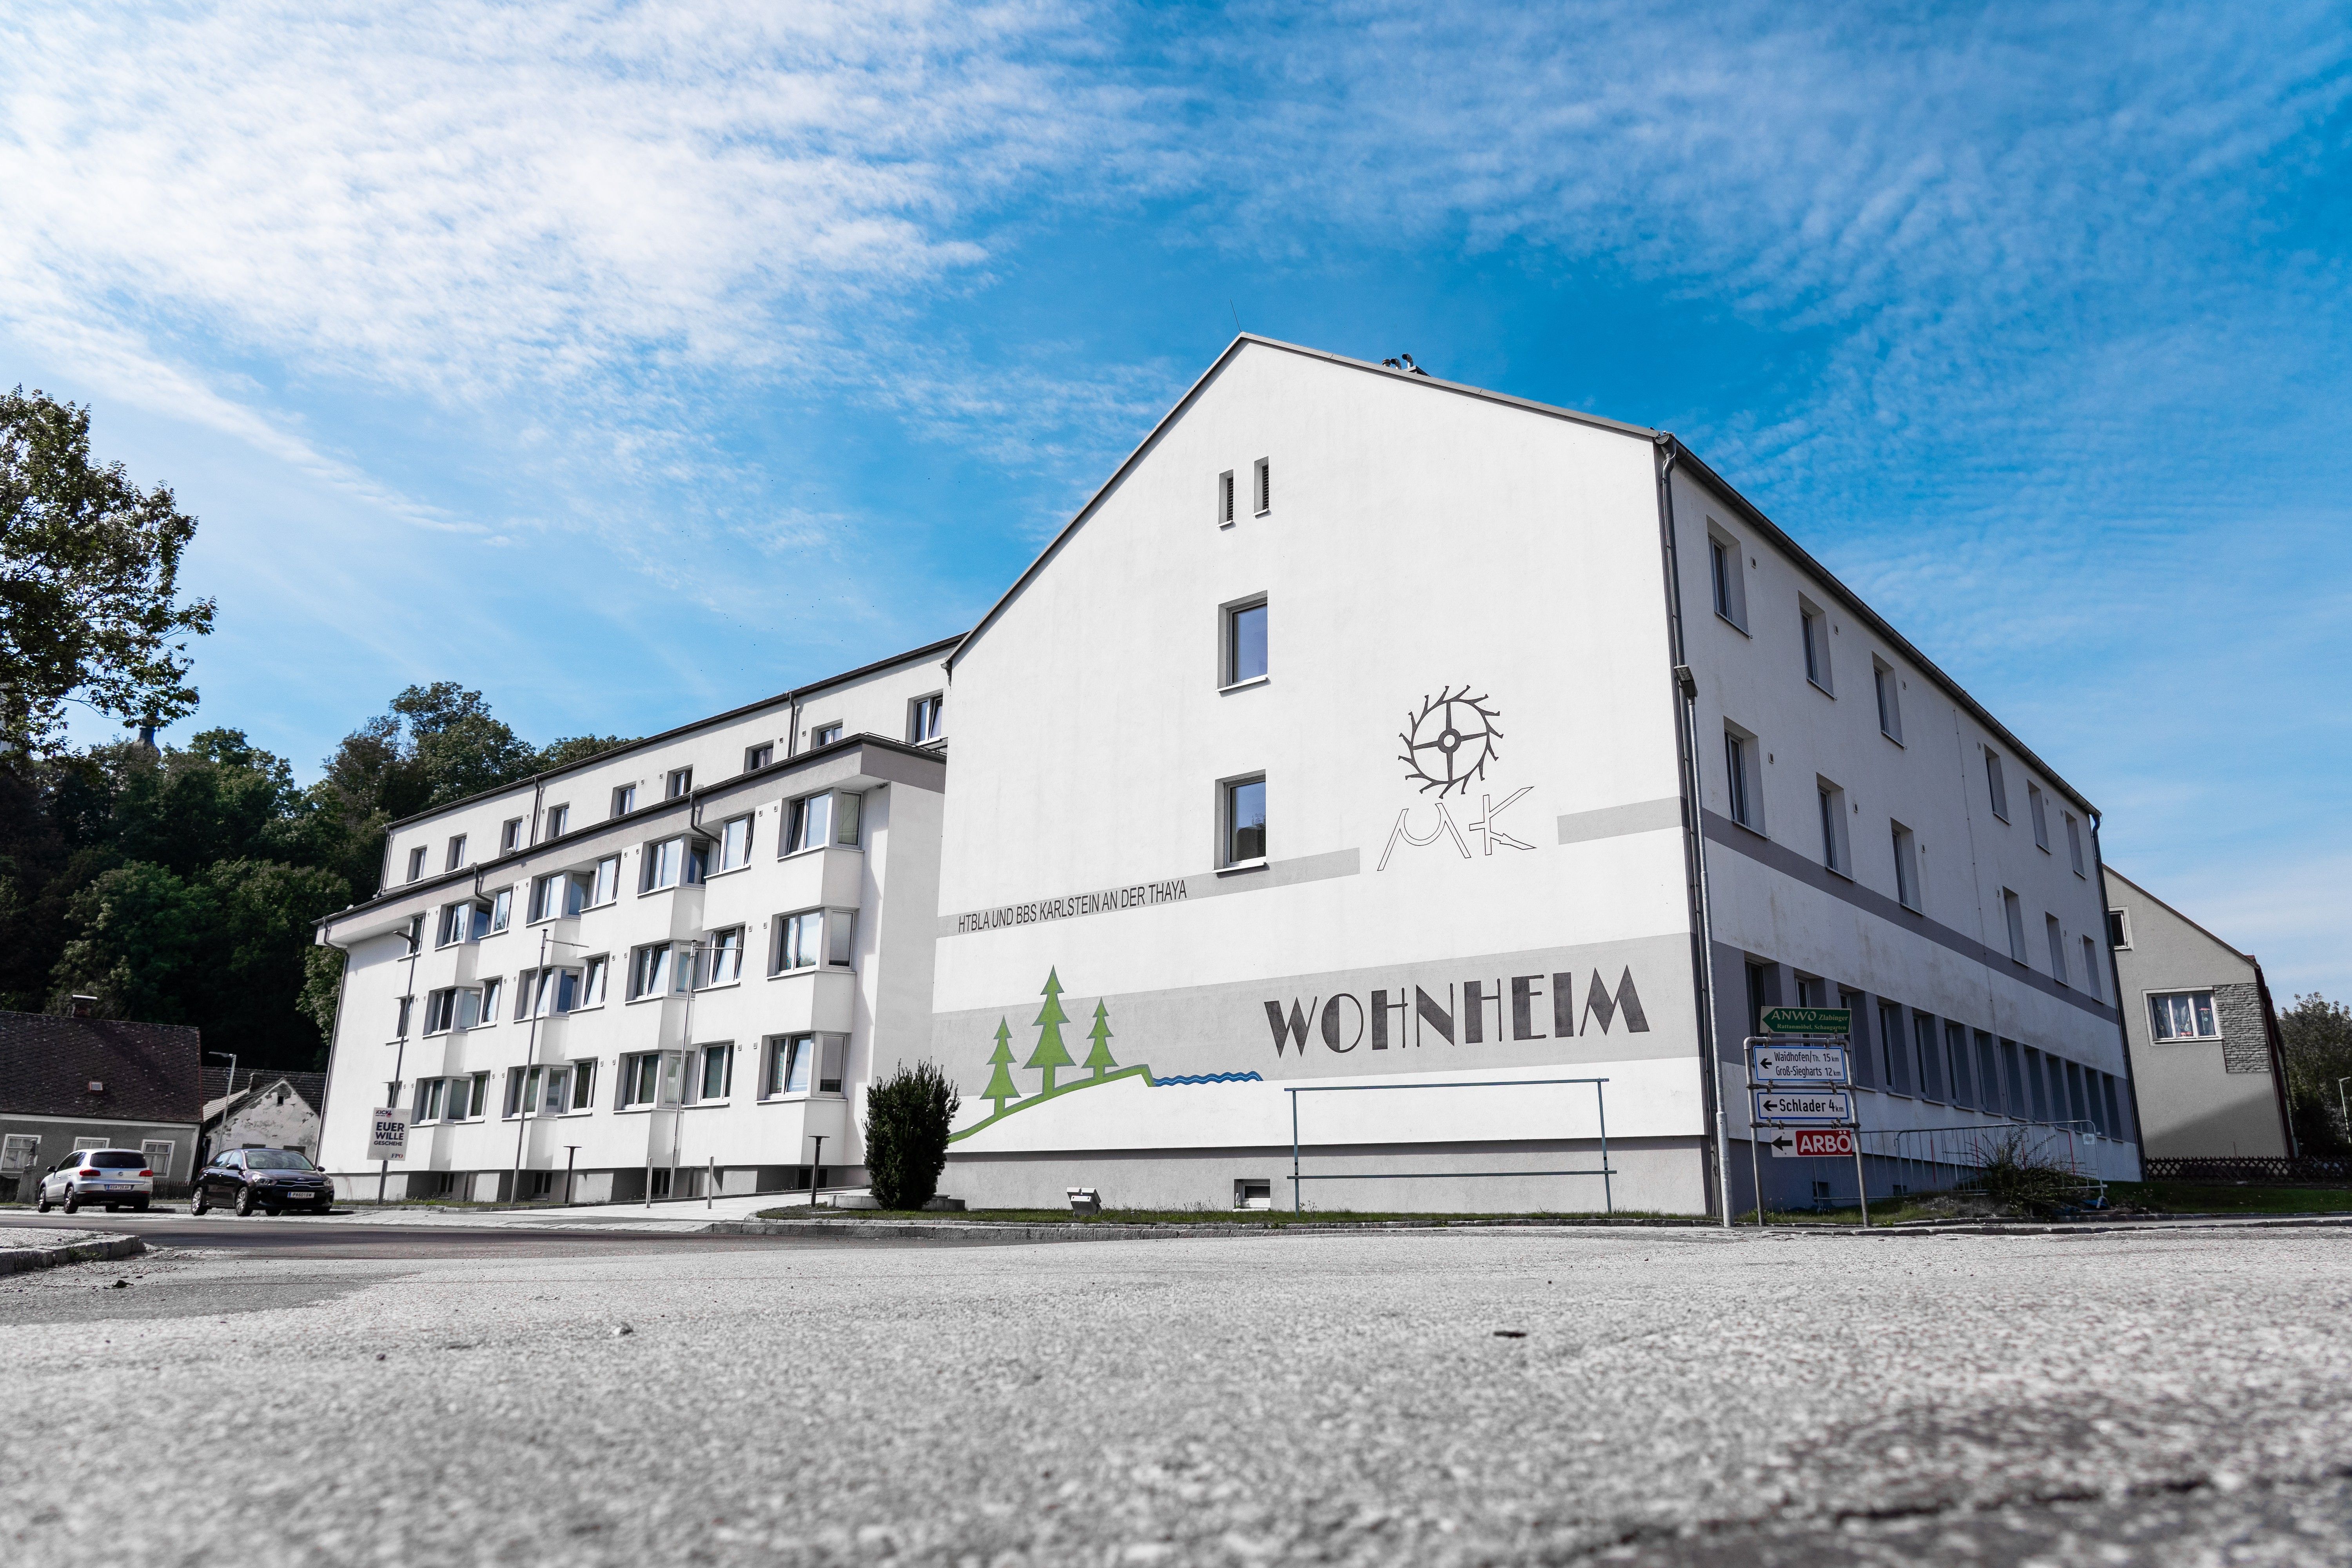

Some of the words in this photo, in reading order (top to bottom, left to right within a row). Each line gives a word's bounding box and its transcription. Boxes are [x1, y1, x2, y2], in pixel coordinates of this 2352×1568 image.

[958, 911, 989, 933] HTBLA
[992, 908, 1013, 928] UND
[1016, 904, 1037, 924] BBS
[1040, 893, 1099, 920] KARLSTEIN
[1102, 890, 1118, 911] AN
[1122, 886, 1145, 908] DER
[1148, 880, 1187, 904] THAYA
[1263, 964, 1650, 1059] WOHNHEIM
[1771, 1010, 1817, 1021] ANWO
[1823, 1053, 1831, 1062] 15
[1776, 1065, 1822, 1078] Groß-Siegharts
[1825, 1068, 1833, 1076] 12
[1779, 1098, 1826, 1112] Schlader
[376, 1122, 405, 1132] EUER
[375, 1132, 404, 1140] WILLE
[1800, 1131, 1851, 1152] ARBÖ
